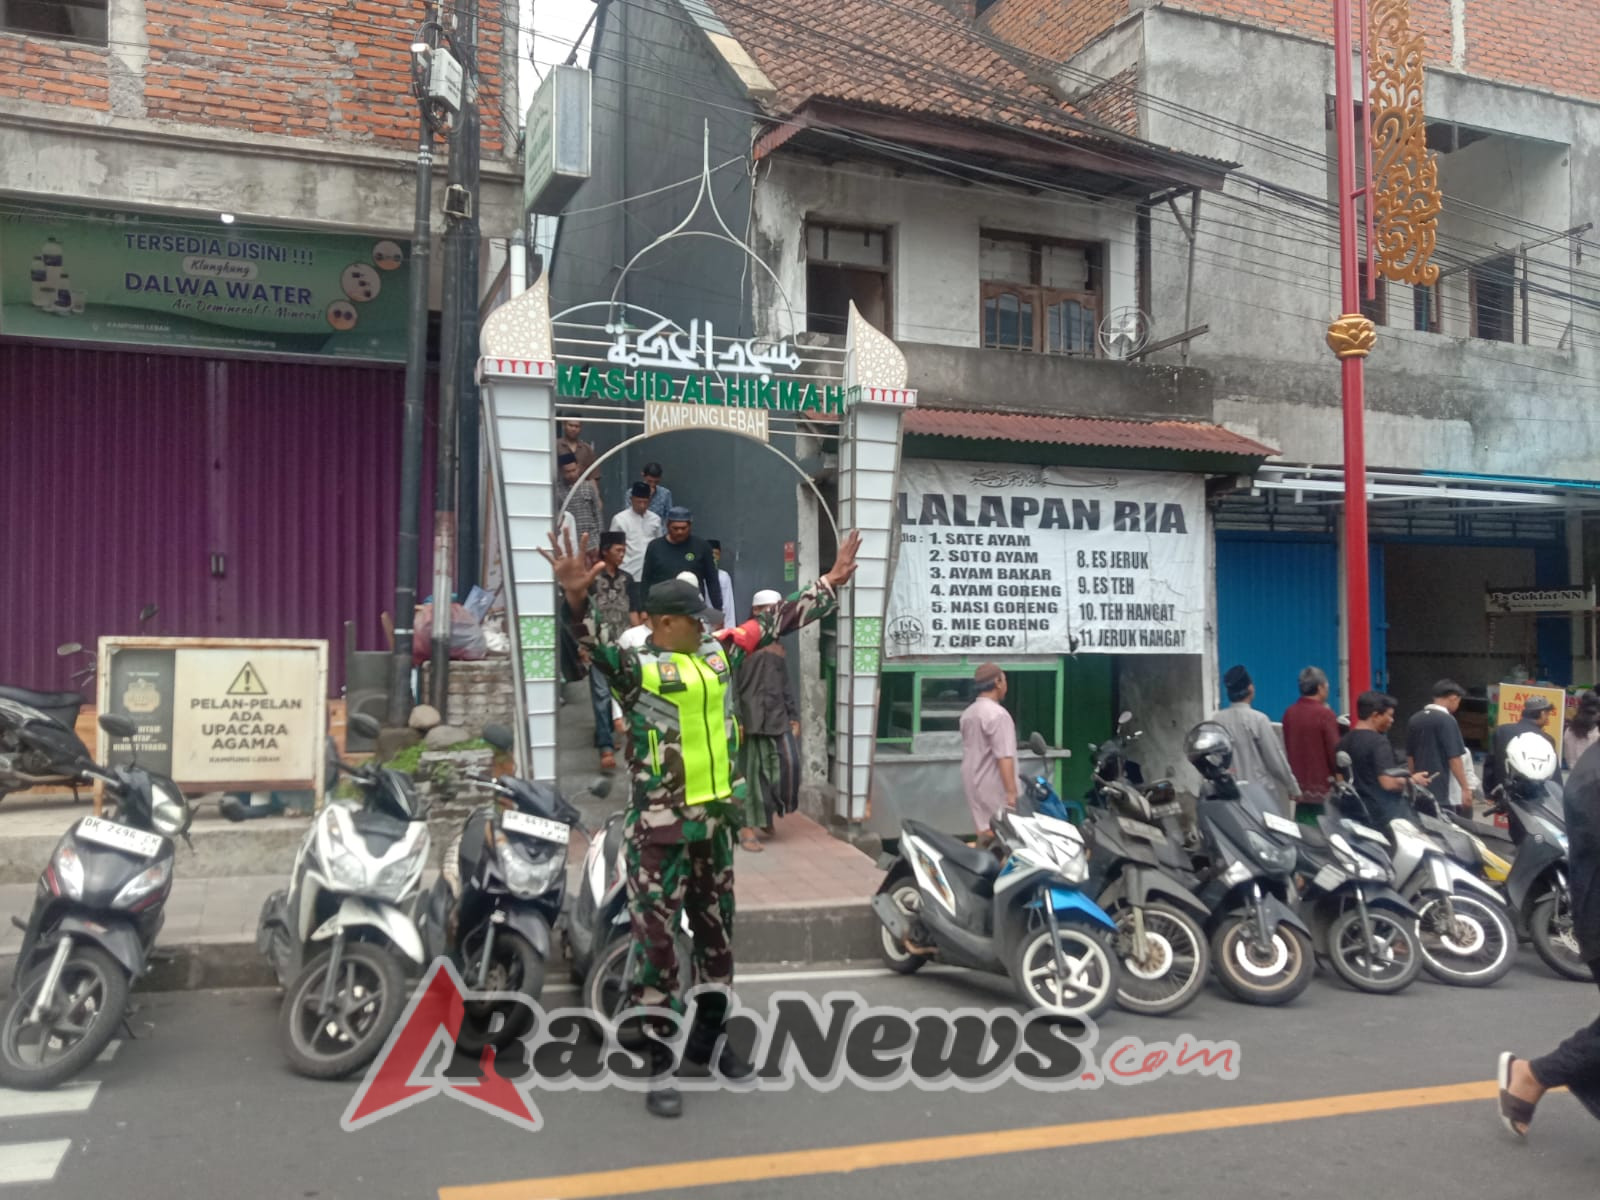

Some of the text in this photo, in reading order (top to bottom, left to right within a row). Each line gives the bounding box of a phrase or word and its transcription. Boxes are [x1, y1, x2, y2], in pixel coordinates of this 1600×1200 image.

[125, 234, 314, 266] TERSEDIA DISINI !!!
[125, 273, 312, 304] DALWA WATER
[172, 298, 191, 309] Air
[556, 365, 675, 402] MASJID
[649, 404, 766, 441] KAMPUNG LEBAH
[899, 492, 1188, 534] LALAPAN RIA
[929, 533, 942, 545] 1.
[946, 533, 983, 546] SATE
[987, 534, 1031, 547] AYAM
[929, 550, 1038, 564] 2. SOTO AYAM
[1076, 550, 1149, 569] 8. ES JERUK
[930, 567, 1052, 581] 3. AYAM BAKAR
[930, 584, 1062, 598] 4. AYAM GORENG
[1078, 576, 1134, 595] 9. ES TEH
[1512, 589, 1557, 601] Coklat
[1561, 591, 1582, 600] NN
[931, 601, 1058, 614] 5. NASI GORENG
[1079, 603, 1175, 622] 10. TEH HANGAT
[932, 618, 948, 631] 6.
[951, 618, 981, 631] MIE
[985, 619, 1050, 631] GORENG
[933, 635, 1016, 648] 7. CAP CAY
[1079, 629, 1186, 647] 11. JERUK HANGAT
[190, 698, 301, 709] PELAN-PELAN
[229, 711, 264, 722] ADA
[201, 723, 288, 736] UPACARA
[211, 737, 279, 750] AGAMA
